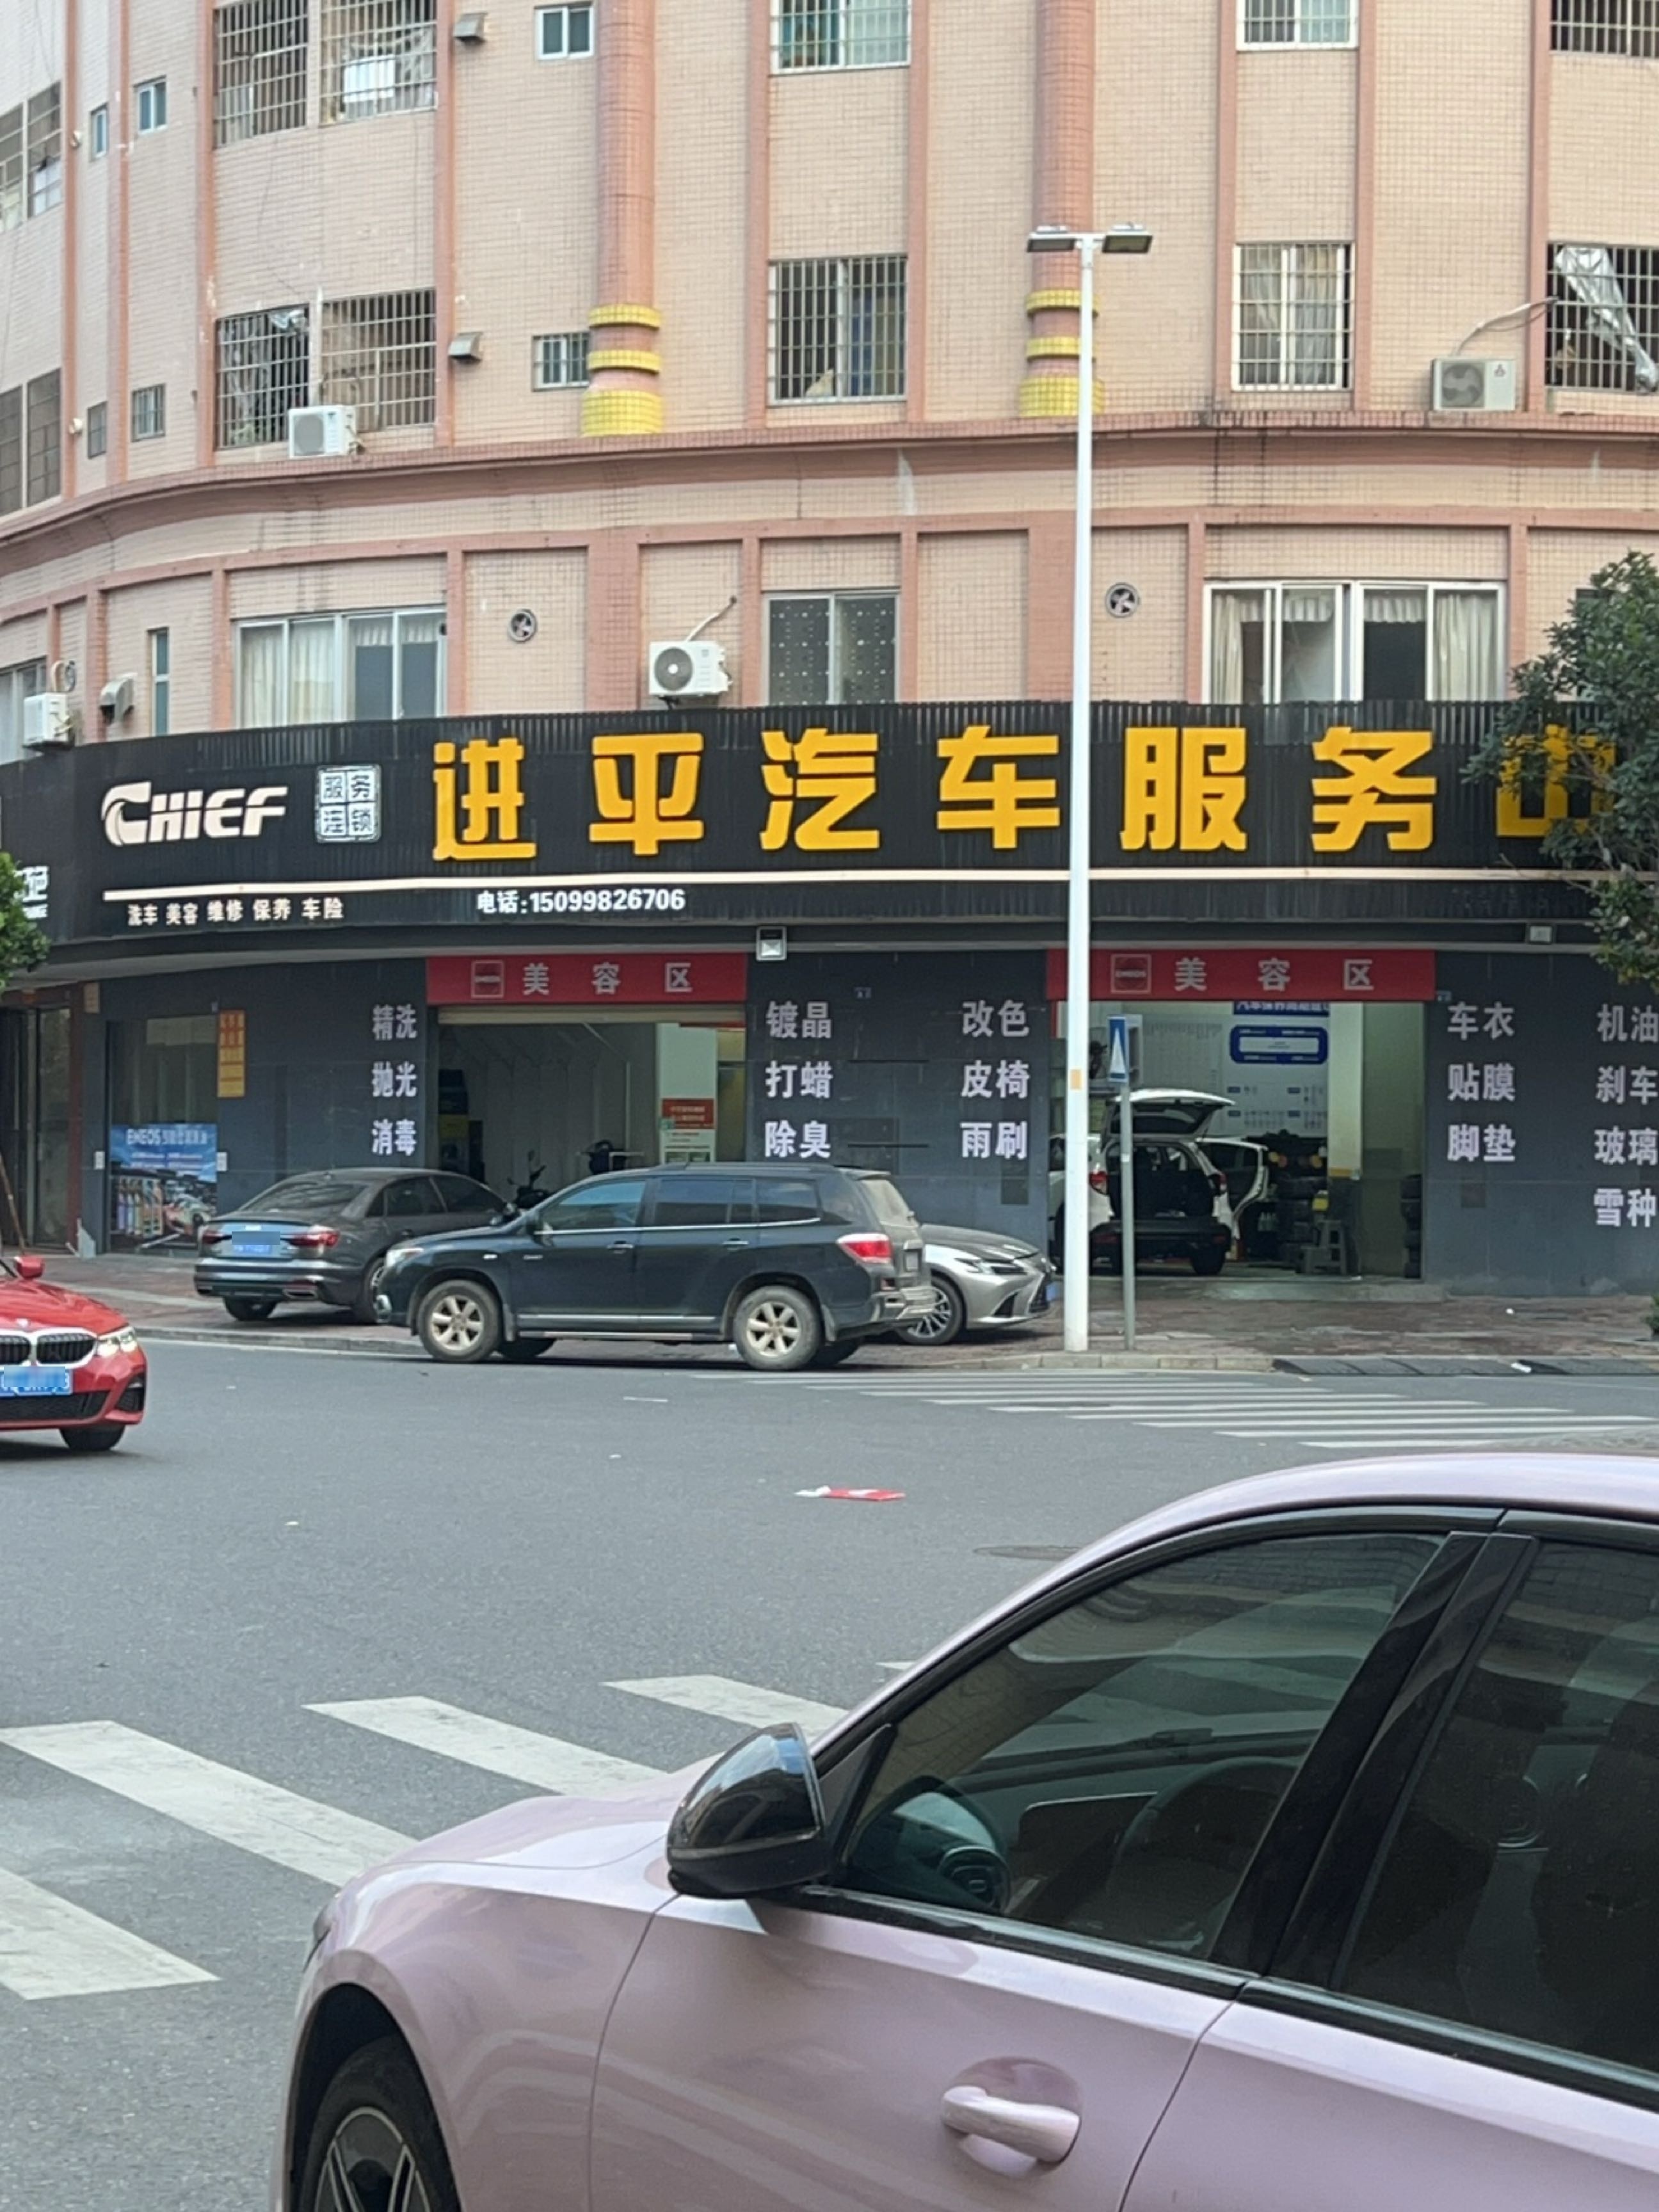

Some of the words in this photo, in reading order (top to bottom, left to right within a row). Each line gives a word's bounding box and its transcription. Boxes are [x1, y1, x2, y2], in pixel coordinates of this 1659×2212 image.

[321, 773, 371, 799] 服务
[101, 781, 288, 846] CHIEF
[128, 903, 158, 926] 洗车
[165, 902, 198, 926] 美容
[207, 899, 244, 922] 维修
[253, 897, 291, 922] 保养
[301, 897, 344, 920] 车险
[476, 888, 686, 914] 电话:15099826706
[522, 961, 693, 996] 美容区
[1174, 957, 1375, 991] 美容区
[372, 1004, 418, 1041] 精洗
[765, 1000, 832, 1039] 镀晶
[961, 999, 1030, 1038] 改色
[1447, 1002, 1515, 1041] 车衣
[1596, 1004, 1659, 1043] 机油
[371, 1061, 418, 1098] 抛光
[765, 1060, 834, 1099] 打蜡
[960, 1059, 1030, 1100] 皮椅
[1447, 1062, 1516, 1102] 贴膜
[1595, 1065, 1659, 1105] 刹车
[371, 1119, 417, 1157] 消毒
[764, 1119, 831, 1159] 除臭
[959, 1121, 1028, 1160] 雨刷
[1447, 1123, 1516, 1163] 脚垫
[1594, 1125, 1659, 1166] 玻璃
[1594, 1187, 1657, 1228] 雪种
